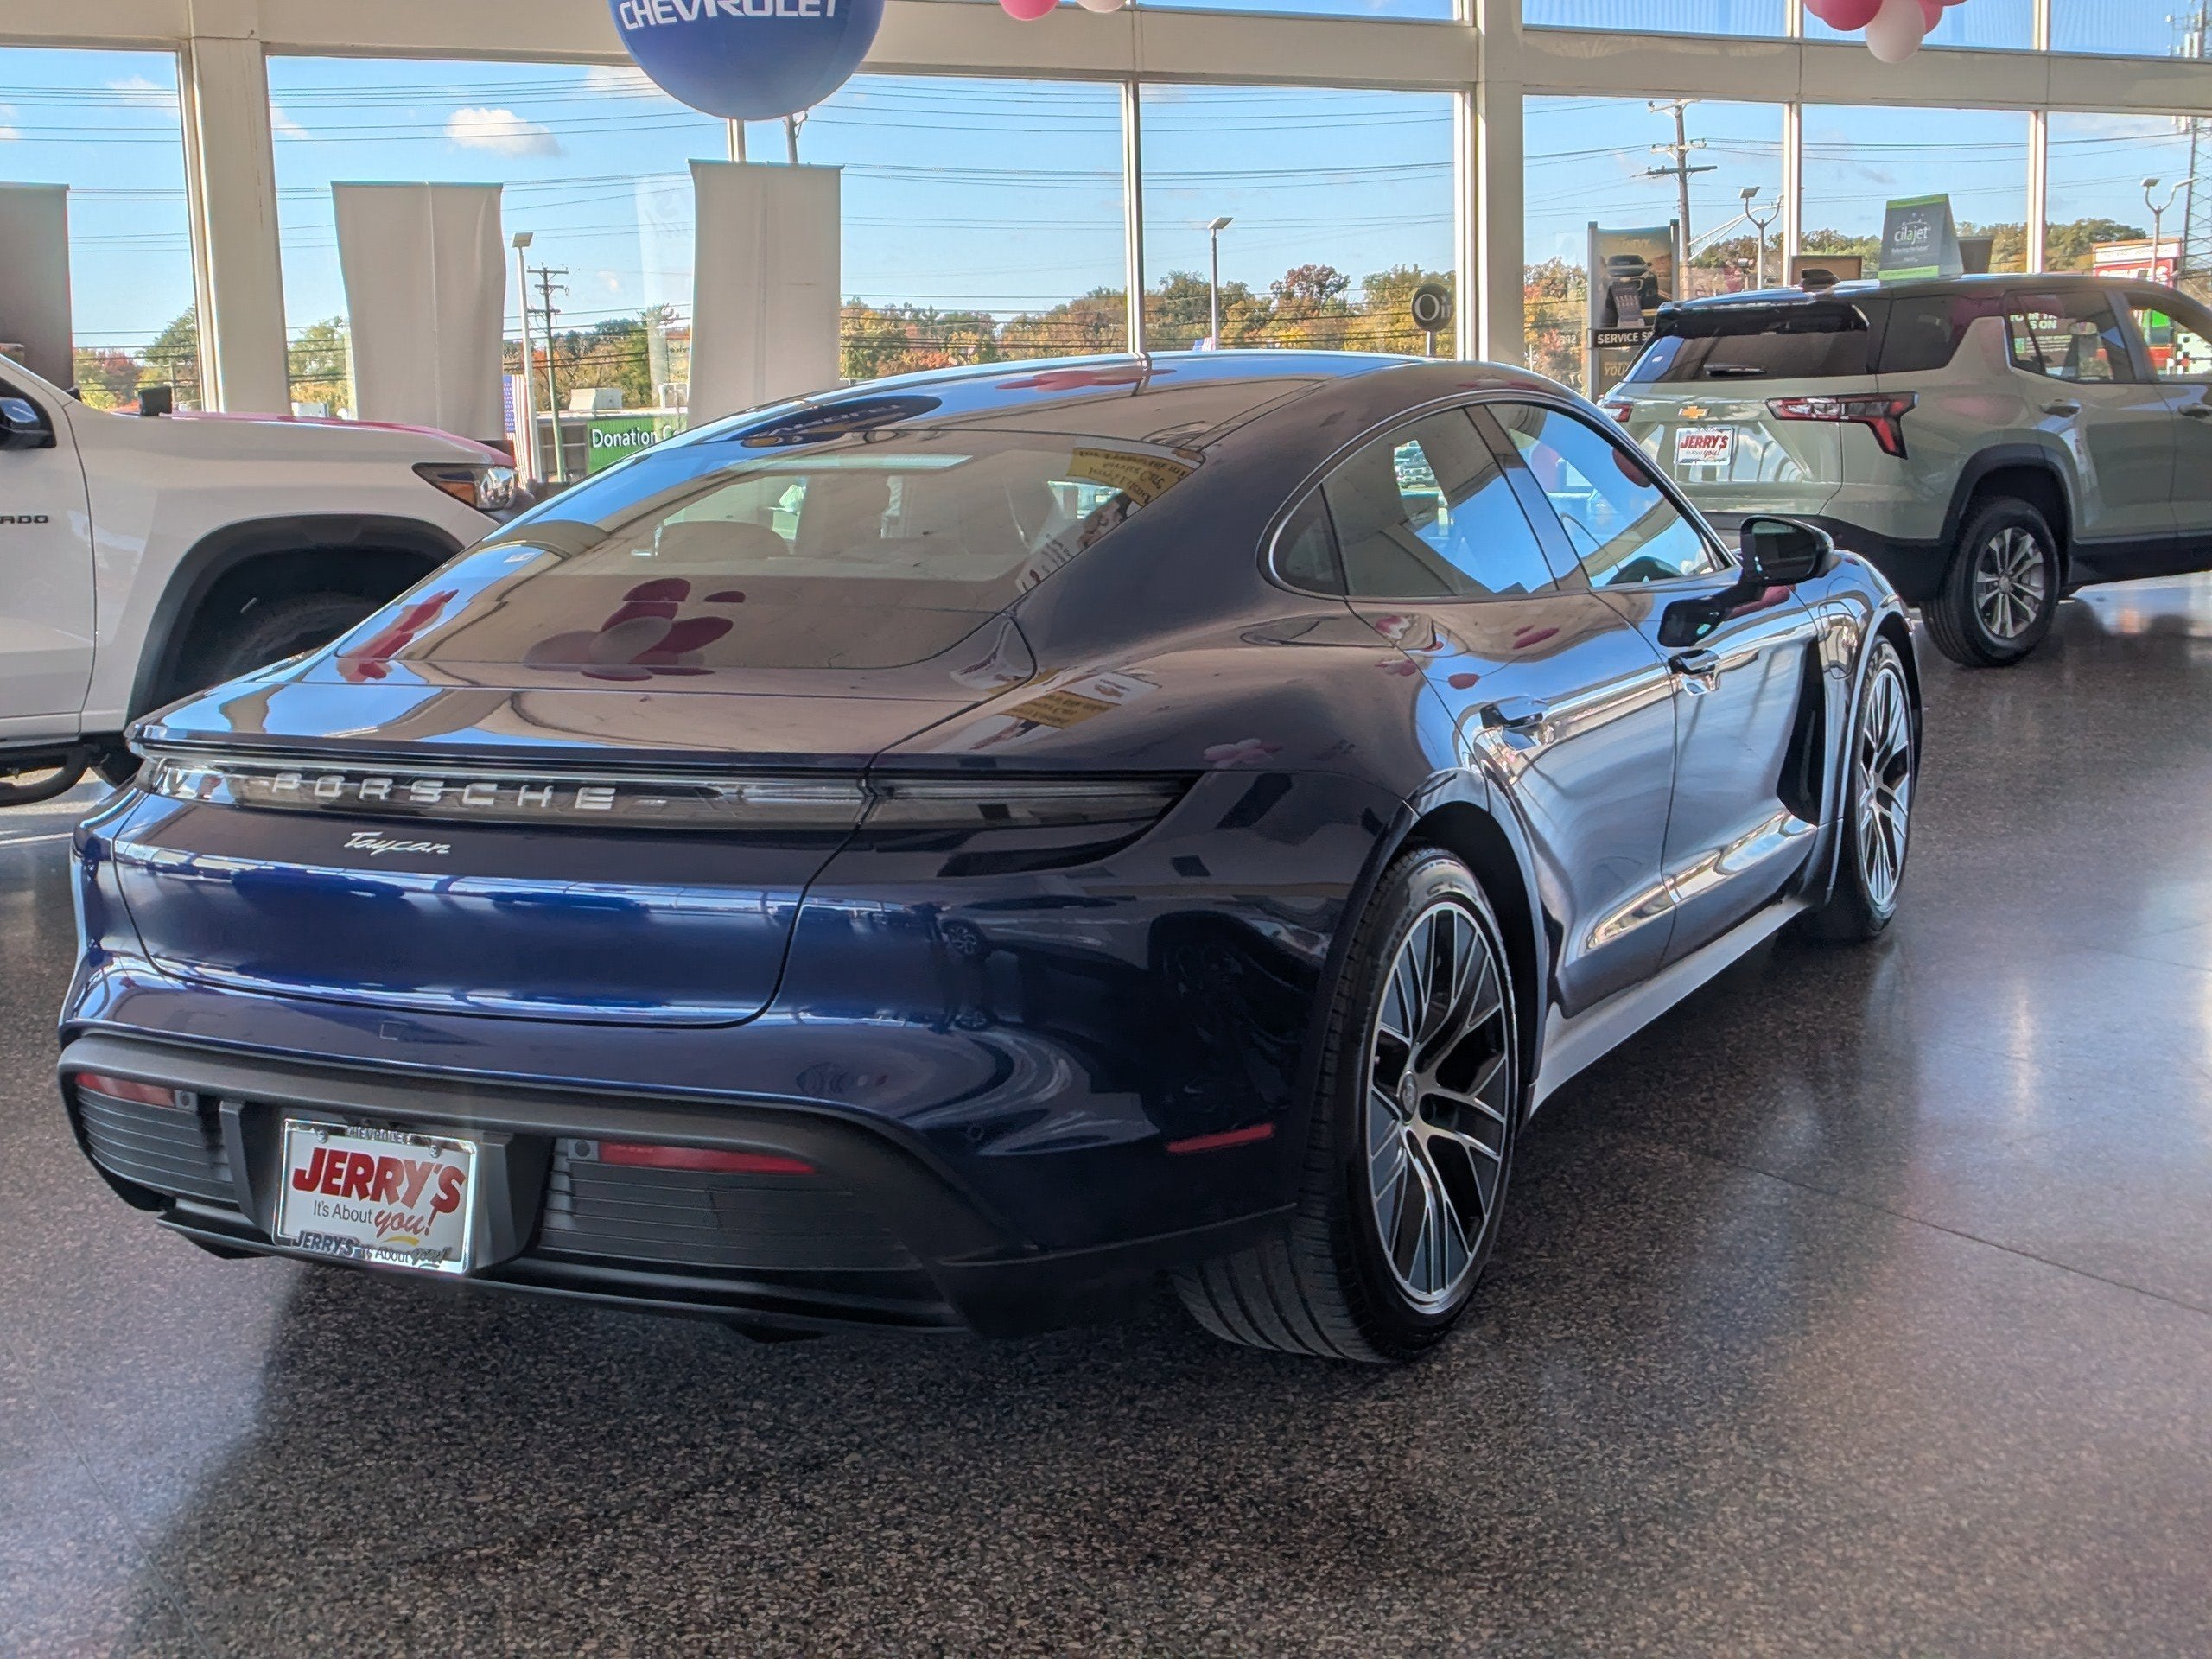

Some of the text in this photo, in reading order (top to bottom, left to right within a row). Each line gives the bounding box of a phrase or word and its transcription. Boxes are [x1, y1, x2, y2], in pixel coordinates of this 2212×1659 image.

[619, 0, 836, 30] CHEVROLET
[1893, 225, 1928, 245] cilajet
[1597, 332, 1639, 344] SERVICE
[591, 427, 658, 448] Donation
[1680, 435, 1729, 448] JERRY'S
[272, 772, 616, 810] PORSCHE
[343, 830, 451, 856] Taycan
[346, 1126, 413, 1145] CHEVROLET
[292, 1147, 467, 1214] JERRY'S
[314, 1200, 438, 1239] It's About you!
[292, 1230, 357, 1258] JERRY'S
[374, 1246, 410, 1264] About
